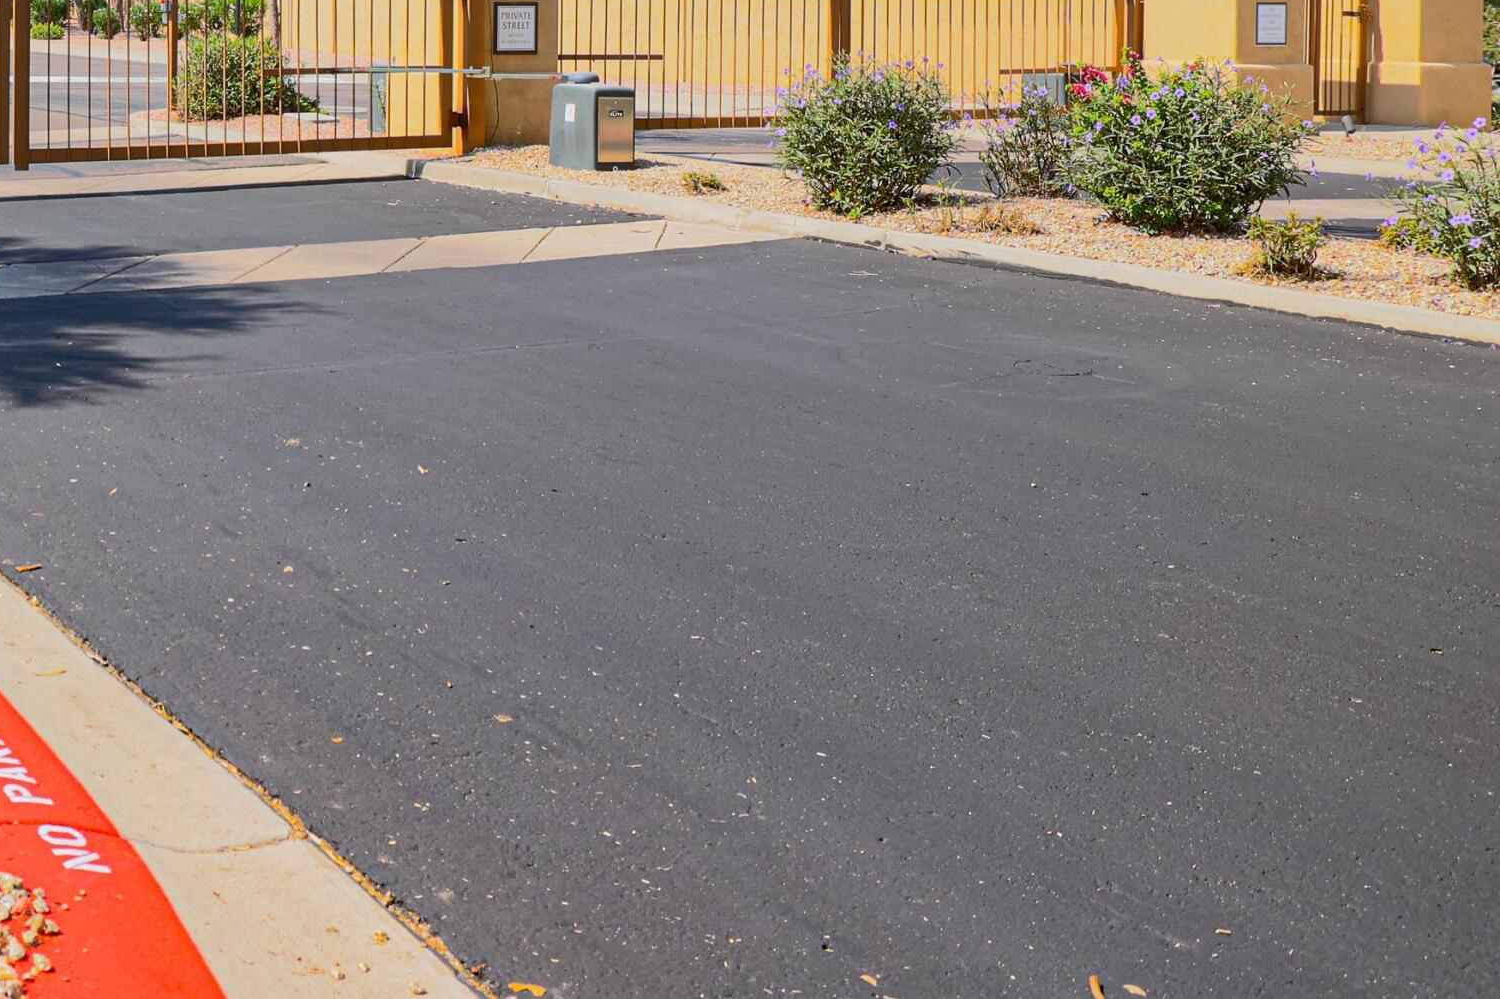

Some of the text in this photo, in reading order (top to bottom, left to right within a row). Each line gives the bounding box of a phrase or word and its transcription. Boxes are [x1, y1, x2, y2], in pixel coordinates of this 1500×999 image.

[500, 11, 532, 20] PRIVATE
[502, 21, 530, 30] STREET
[37, 824, 112, 874] NO
